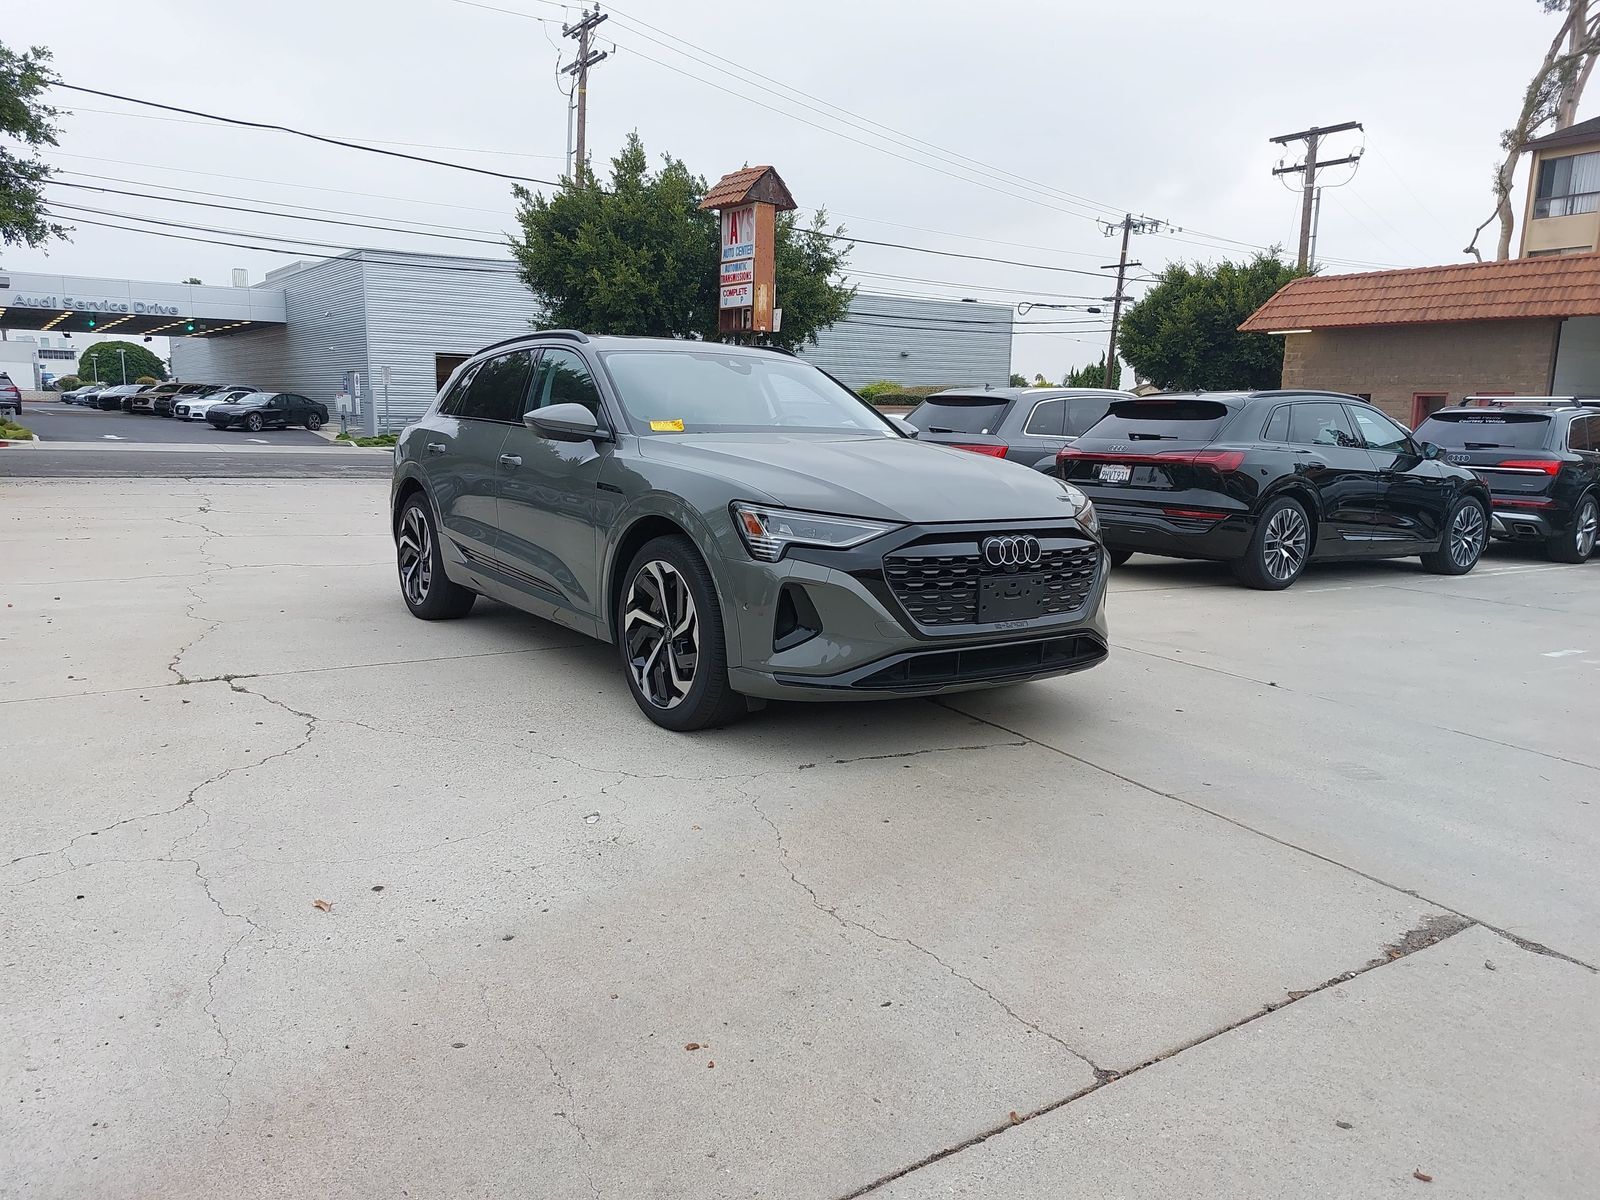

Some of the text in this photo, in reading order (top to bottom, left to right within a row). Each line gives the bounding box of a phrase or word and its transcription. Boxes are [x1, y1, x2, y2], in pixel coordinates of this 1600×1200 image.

[723, 208, 754, 246] JAY'S
[722, 244, 754, 259] AUTO CENTER
[724, 262, 748, 273] AUTOMATIC
[720, 271, 752, 284] TRANSMISSIONS
[722, 286, 748, 298] COMPLETE
[12, 294, 179, 315] Audi Service Drive
